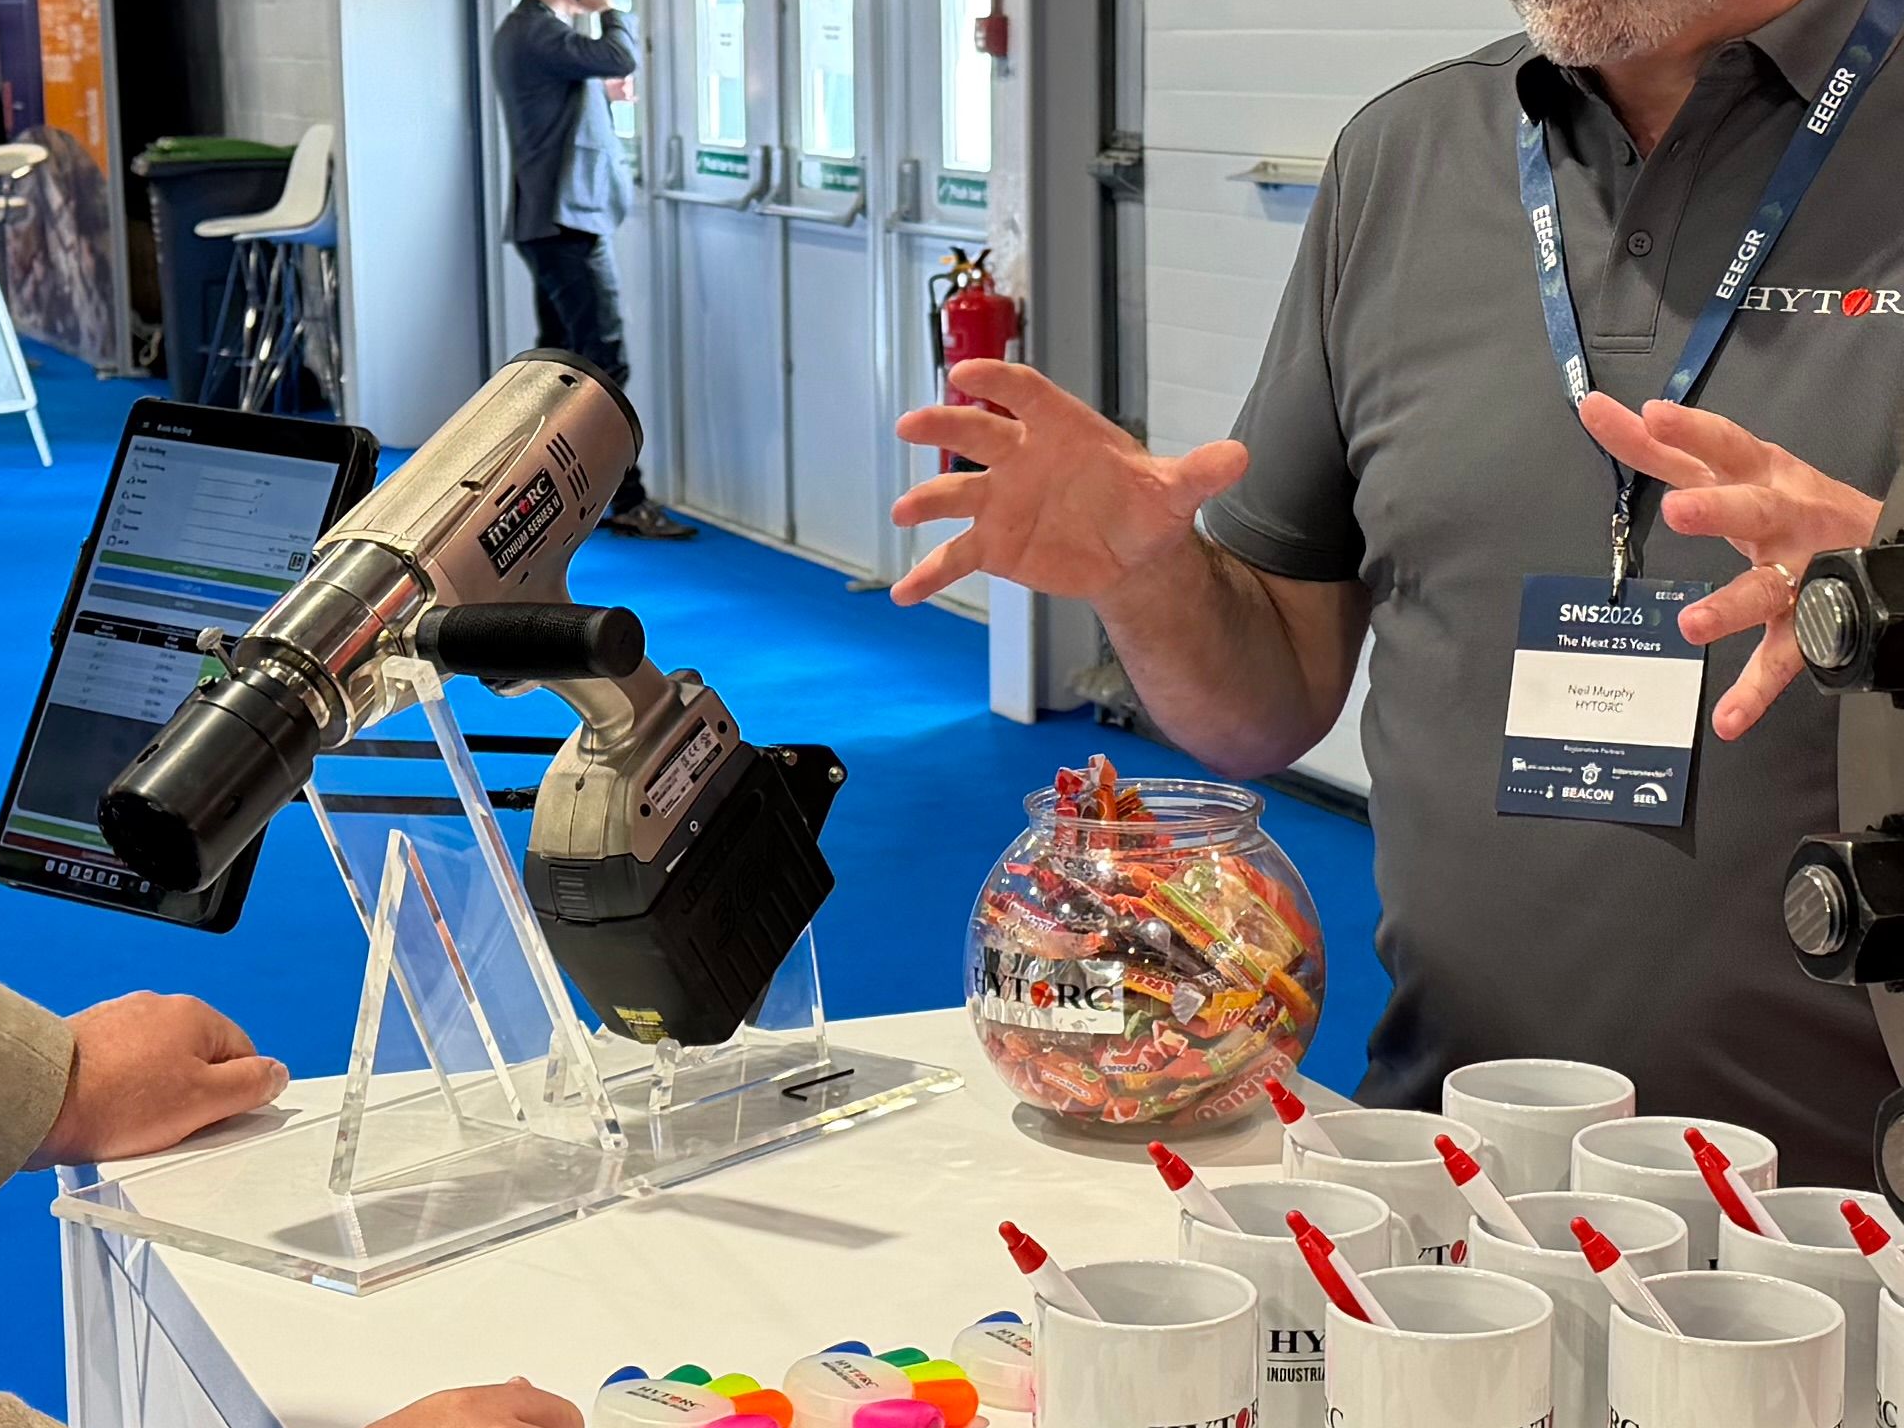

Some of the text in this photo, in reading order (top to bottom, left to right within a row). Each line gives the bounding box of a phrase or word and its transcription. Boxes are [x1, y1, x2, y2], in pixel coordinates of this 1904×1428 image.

[1806, 66, 1856, 135] EEEGR
[1532, 204, 1558, 272] EEEGR
[1715, 228, 1766, 300] EEEGR
[487, 476, 550, 547] HYTORC
[497, 529, 530, 569] LITHIUM
[527, 502, 554, 536] SERIES
[1559, 603, 1643, 626] SNS2026
[1557, 635, 1661, 652] The Next 25 Years
[1567, 684, 1636, 701] Neil Murphy
[1575, 700, 1624, 714] HYTORC
[1562, 787, 1614, 801] BEACON
[1633, 794, 1658, 804] SEEL
